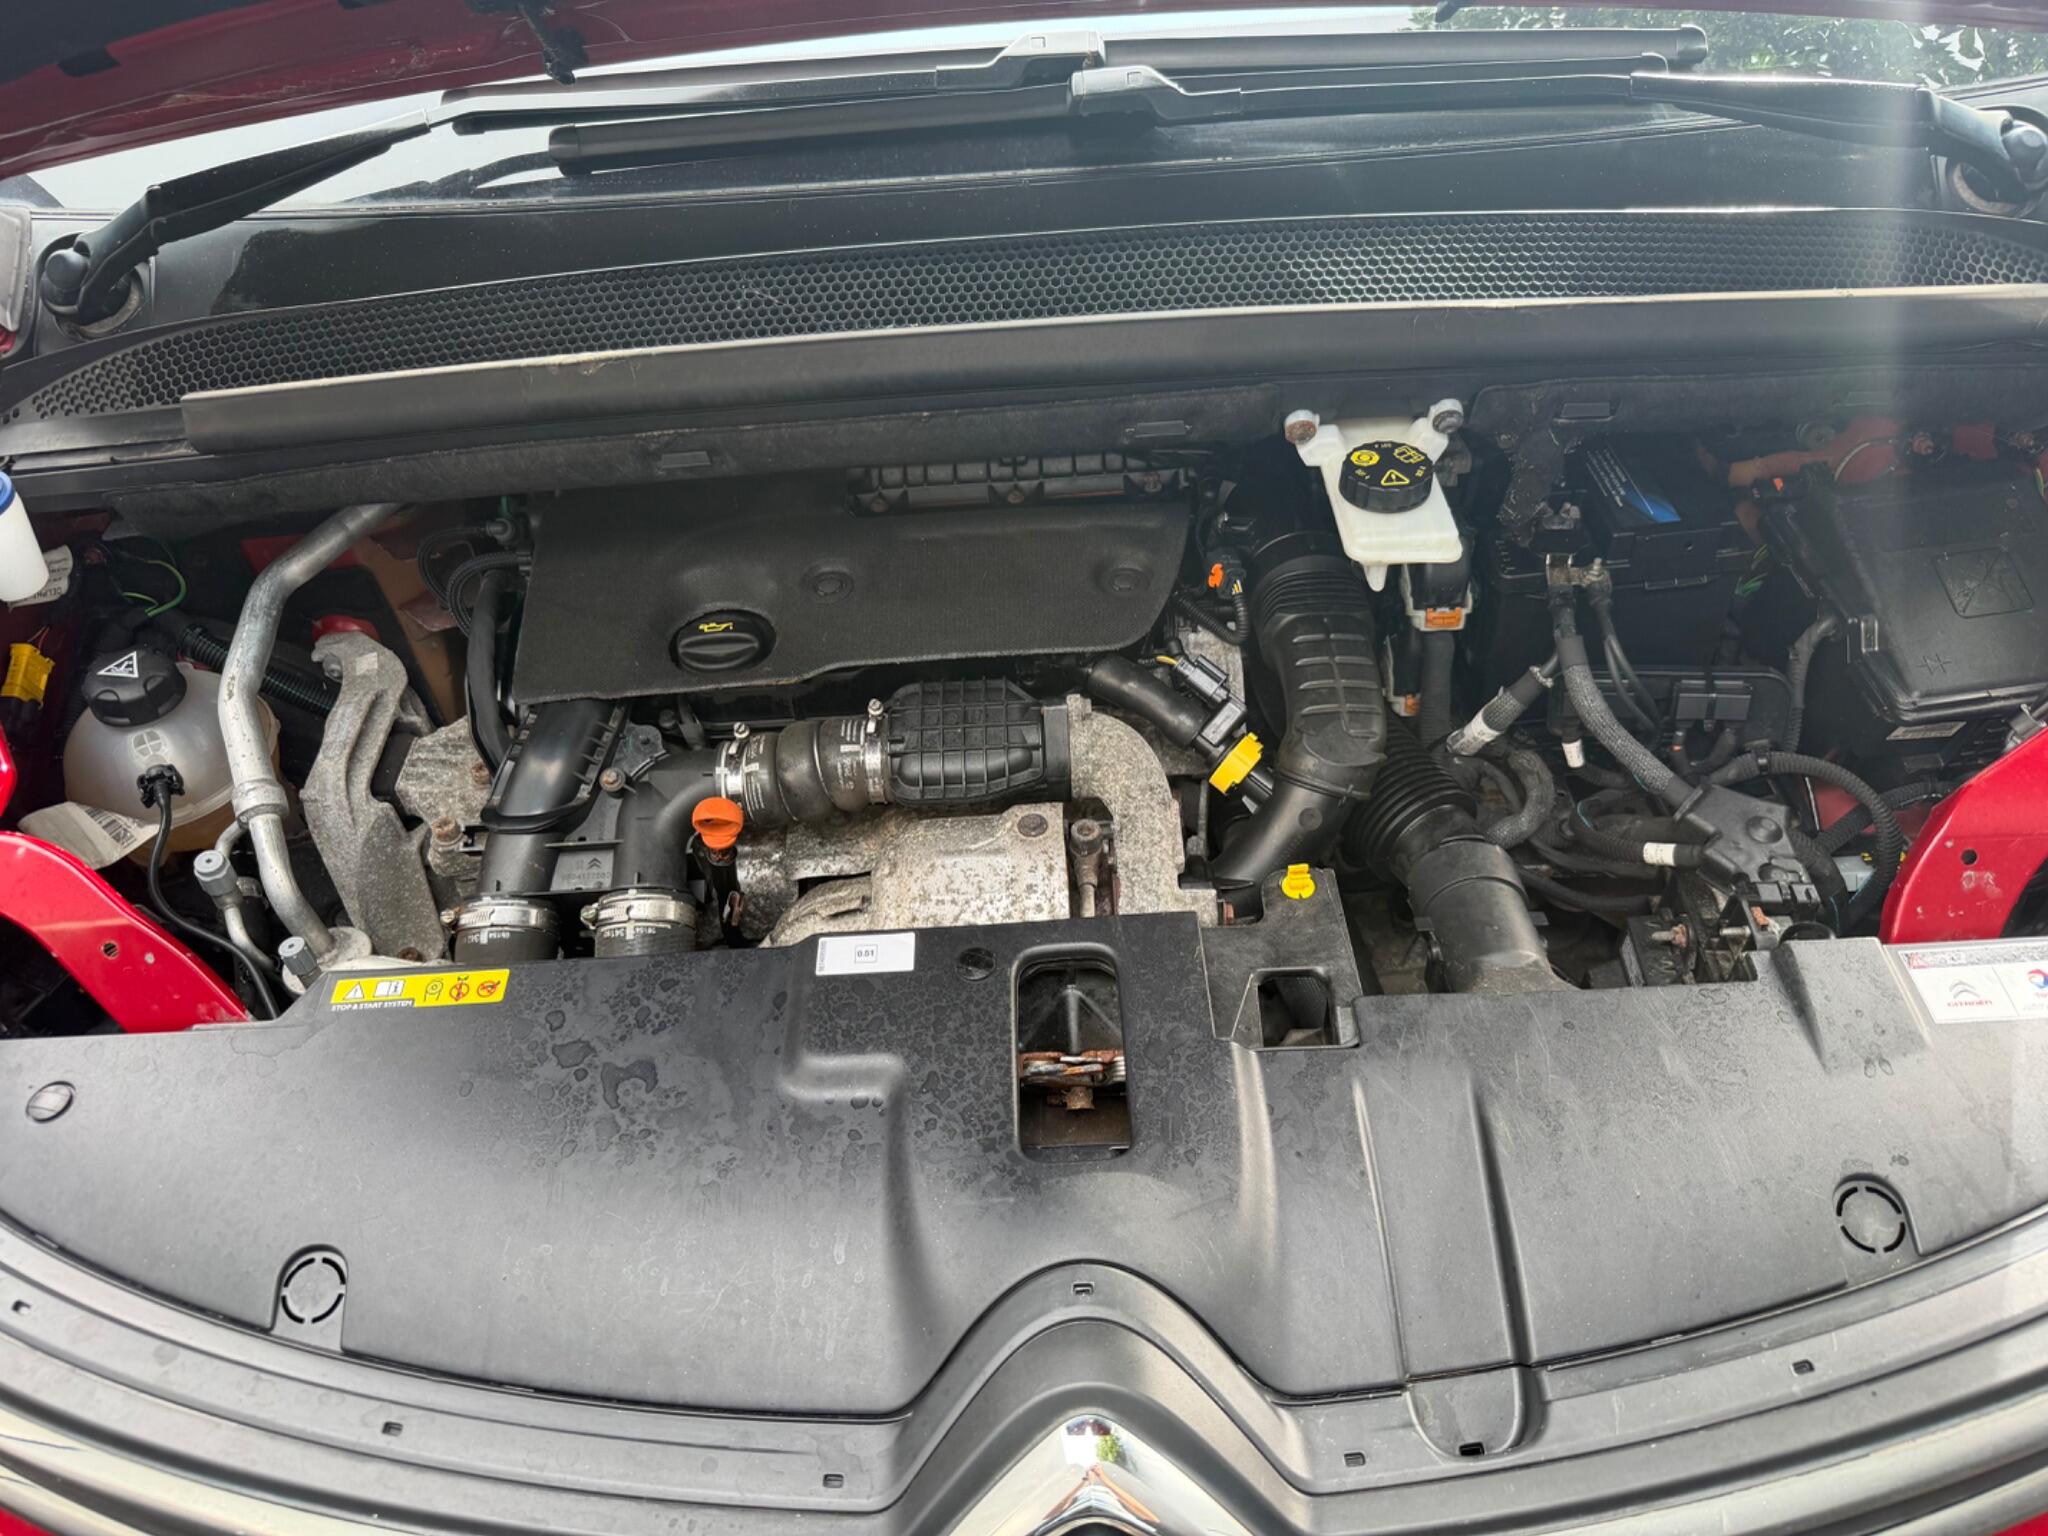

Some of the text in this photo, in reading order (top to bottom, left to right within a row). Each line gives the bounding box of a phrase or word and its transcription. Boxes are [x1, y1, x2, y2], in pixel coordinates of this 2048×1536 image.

[331, 1003, 352, 1012] STOP
[359, 1001, 383, 1010] START
[384, 1000, 412, 1008] SYSTEM
